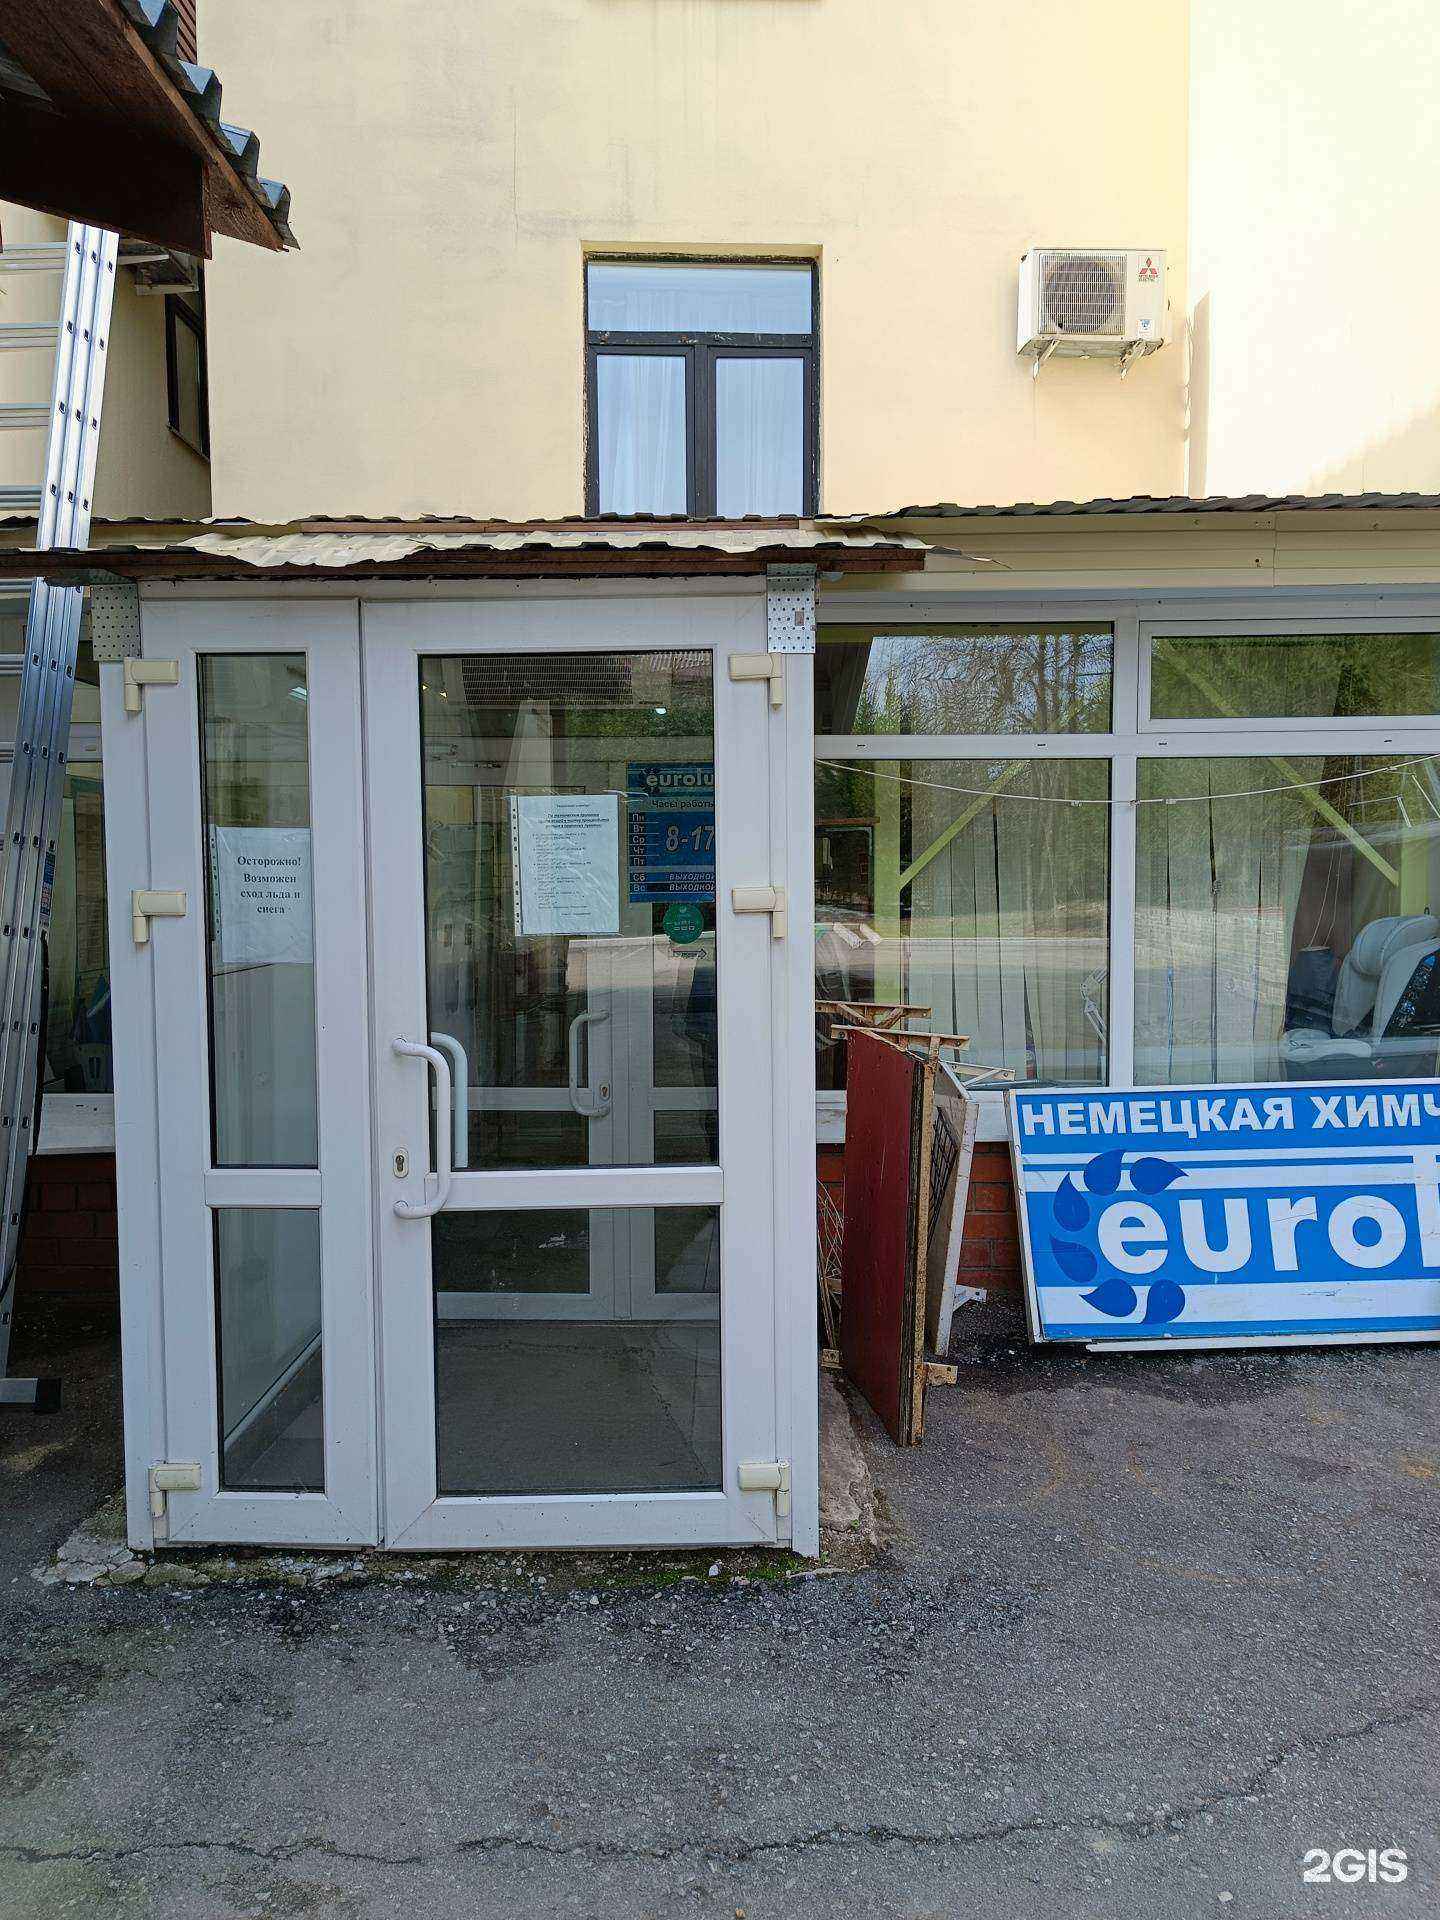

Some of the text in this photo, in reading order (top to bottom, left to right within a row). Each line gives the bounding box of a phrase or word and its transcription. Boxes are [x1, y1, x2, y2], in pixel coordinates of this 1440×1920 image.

[632, 824, 645, 833] Вт
[632, 835, 645, 845] Ср
[237, 856, 301, 867] Осторожно!
[633, 857, 645, 866] Пт
[243, 874, 297, 883] Возможен
[633, 873, 646, 882] Сб
[240, 891, 264, 900] сход
[266, 891, 291, 900] льда
[256, 906, 285, 914] снега
[1021, 1096, 1295, 1139] НЕМЕЦКАЯ
